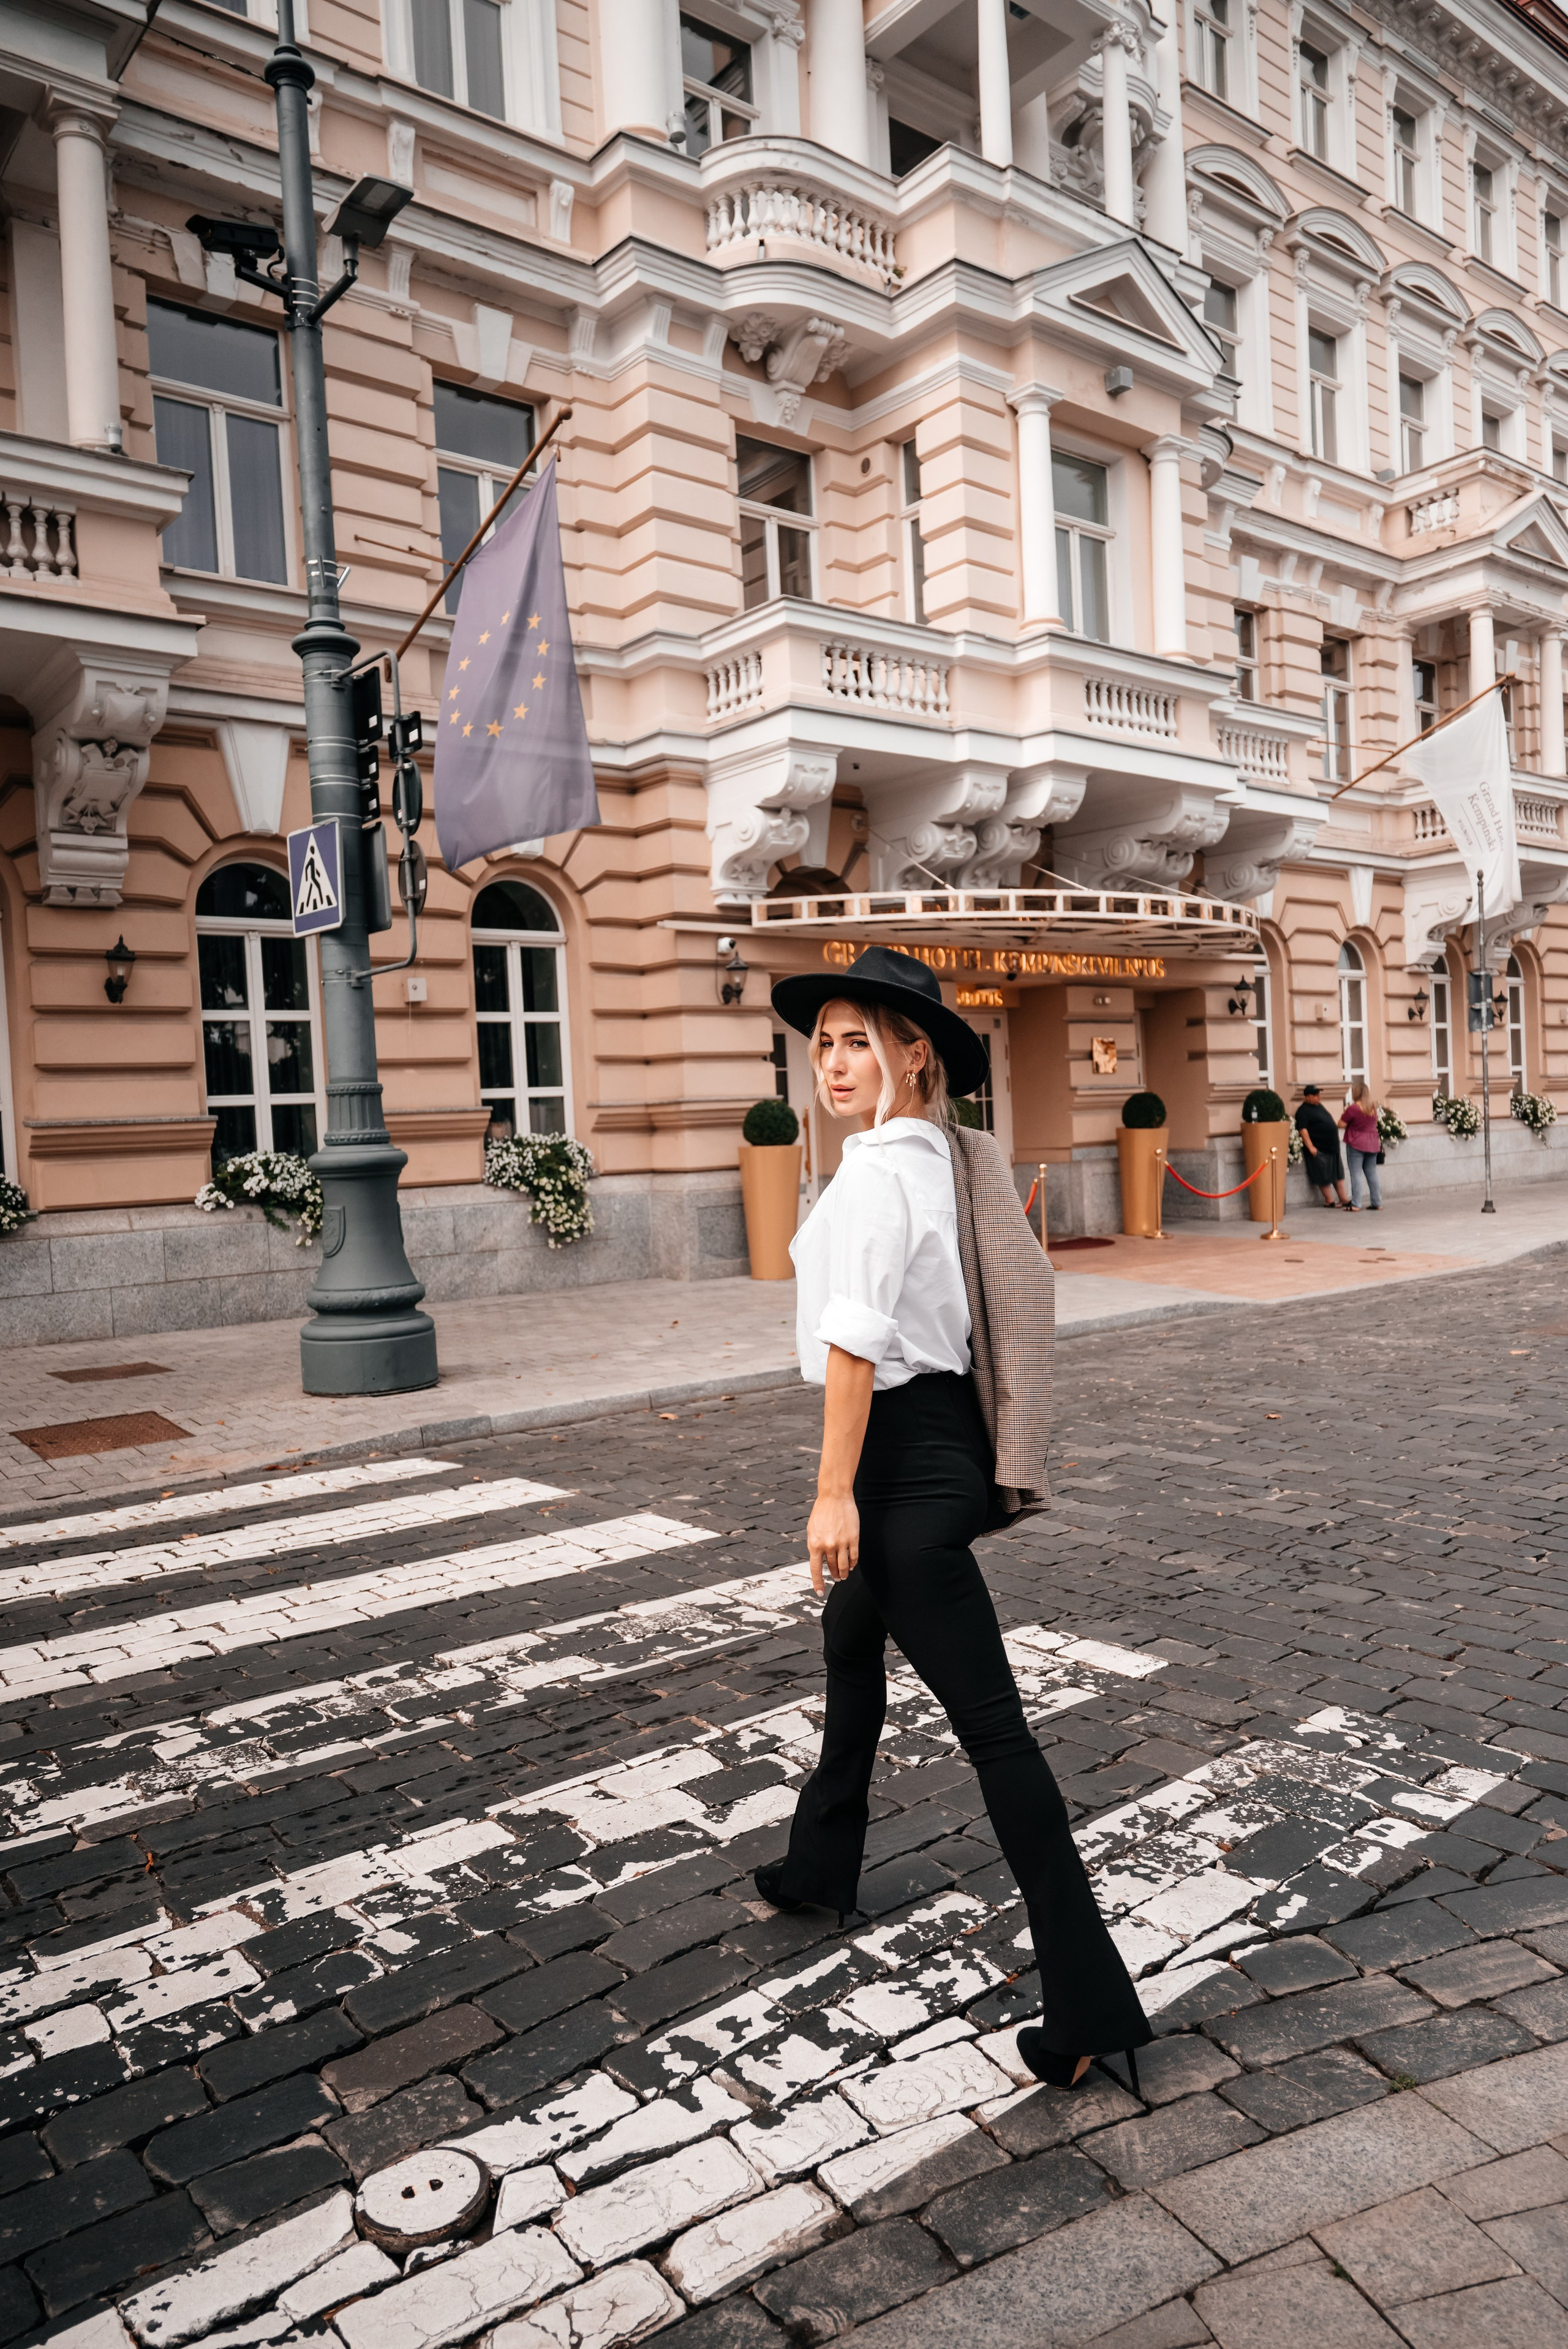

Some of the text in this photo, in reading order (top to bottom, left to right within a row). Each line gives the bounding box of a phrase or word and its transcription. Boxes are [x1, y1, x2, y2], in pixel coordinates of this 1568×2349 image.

[1479, 782, 1500, 818] Grand
[1468, 793, 1497, 853] Kempinski
[993, 951, 1096, 975] KEMPINSKI
[1096, 956, 1166, 978] VILNIUS
